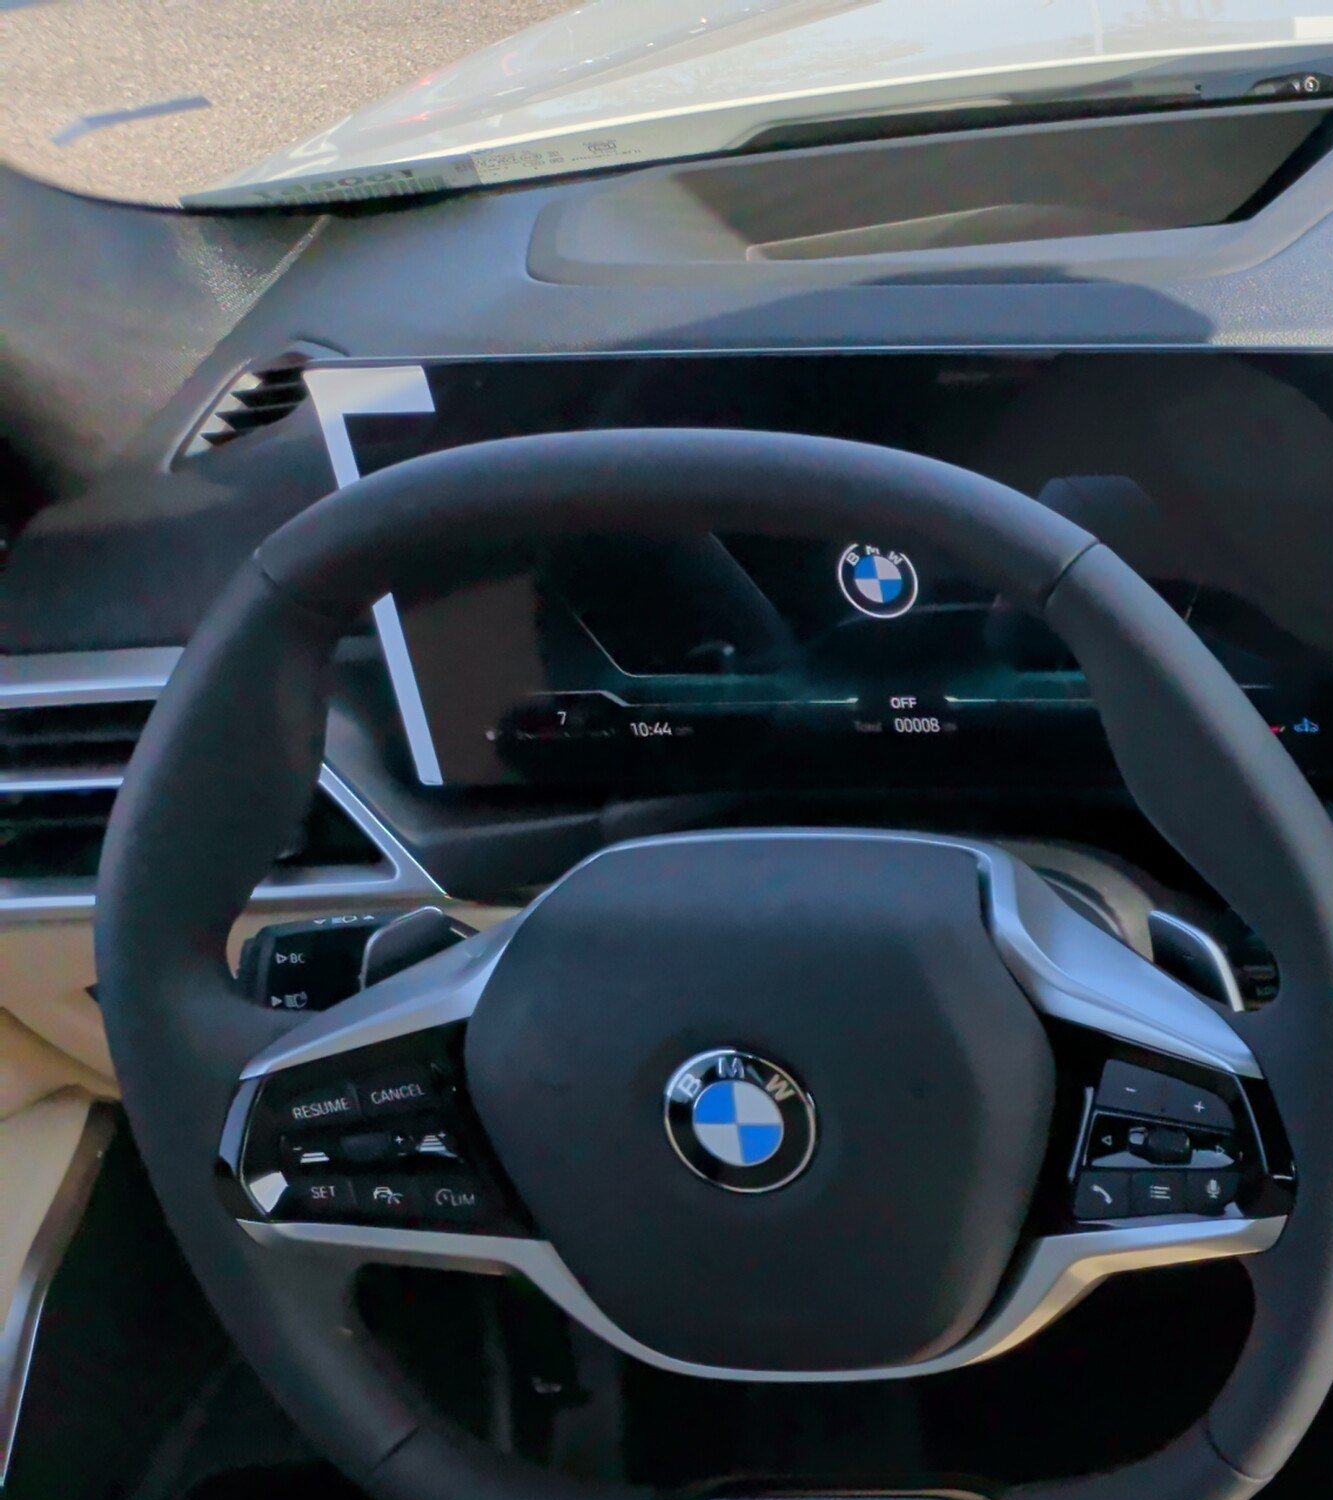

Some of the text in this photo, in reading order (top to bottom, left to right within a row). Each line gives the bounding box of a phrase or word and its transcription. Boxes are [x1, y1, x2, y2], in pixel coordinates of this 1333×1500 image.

[890, 697, 917, 709] OFF
[630, 721, 673, 738] 10:44
[894, 717, 941, 733] 00008
[677, 1056, 796, 1102] BMW
[371, 1083, 426, 1106] CANCEL
[292, 1097, 350, 1120] RESUME
[310, 1185, 336, 1200] SET
[451, 1192, 476, 1207] LIM
